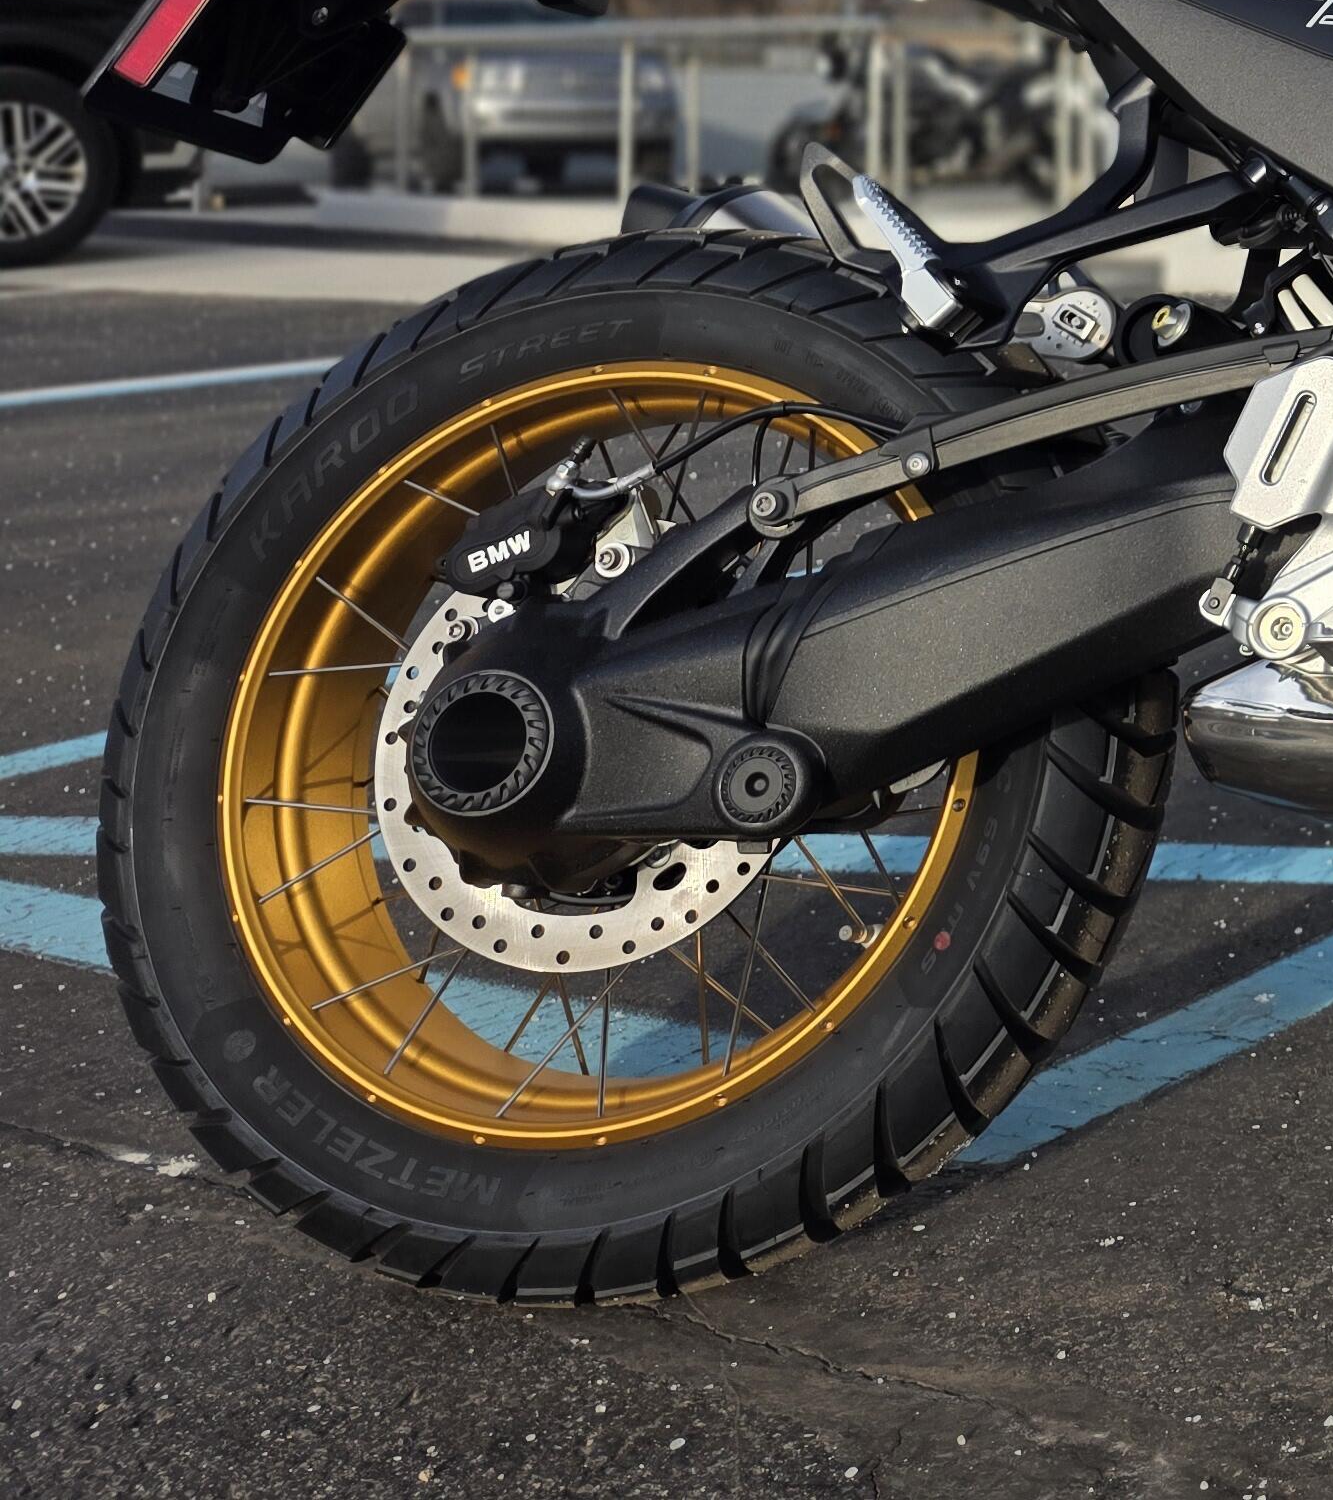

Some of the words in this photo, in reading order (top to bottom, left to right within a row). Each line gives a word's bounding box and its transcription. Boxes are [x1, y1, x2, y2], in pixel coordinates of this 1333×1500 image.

[248, 380, 420, 564] KAROO
[458, 316, 634, 385] STREET
[466, 530, 533, 574] BMW
[252, 1064, 503, 1207] METZELER
